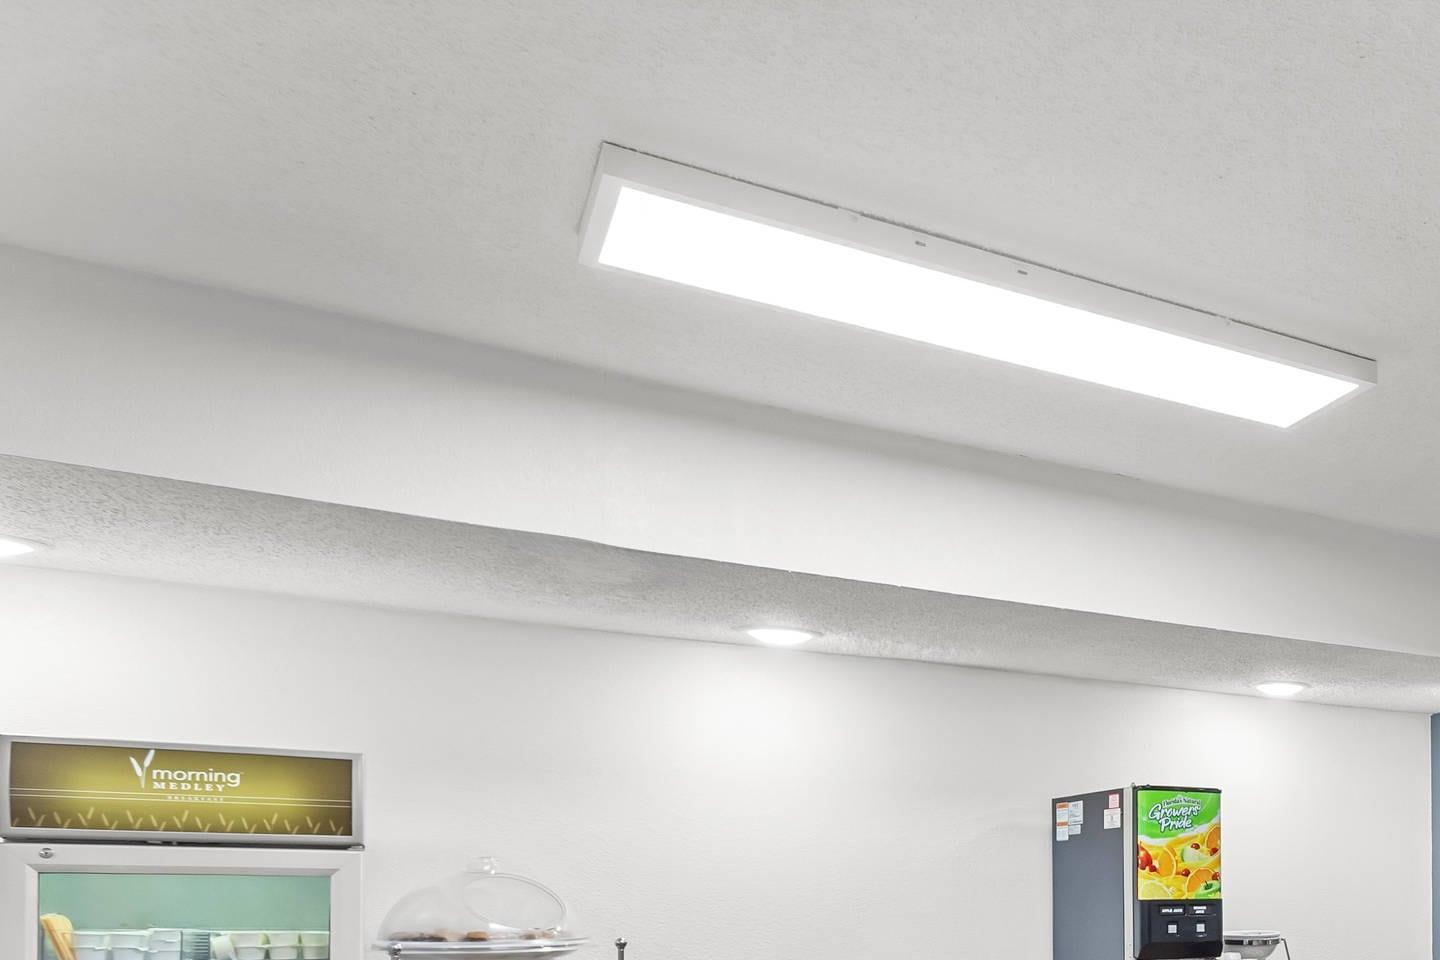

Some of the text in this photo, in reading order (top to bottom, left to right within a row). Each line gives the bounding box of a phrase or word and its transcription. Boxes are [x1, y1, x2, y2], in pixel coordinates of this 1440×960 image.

[152, 768, 241, 788] morning
[152, 781, 225, 792] MEDLEY
[1159, 815, 1192, 833] Pride
